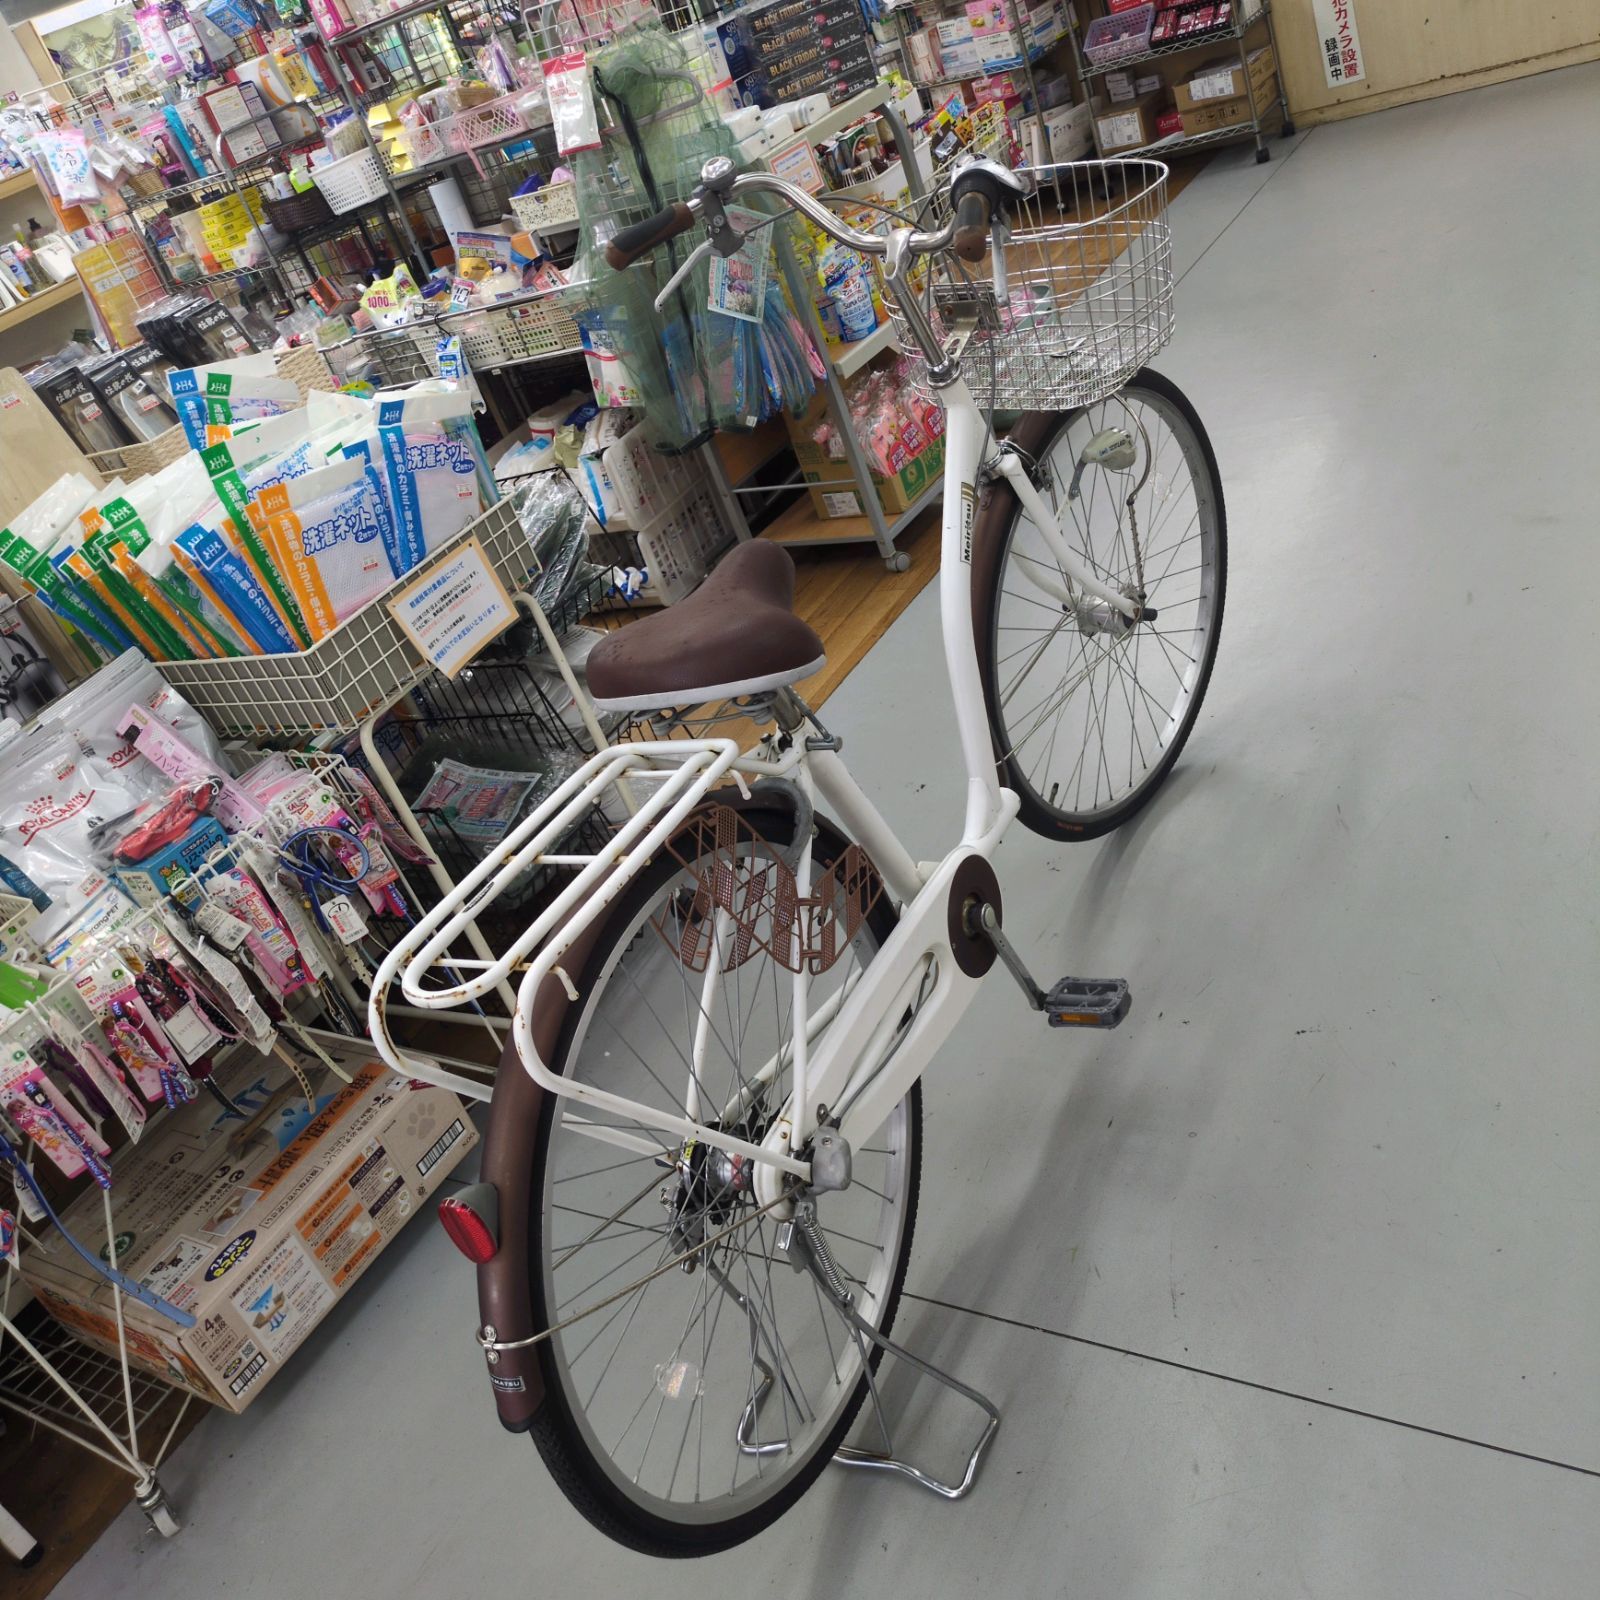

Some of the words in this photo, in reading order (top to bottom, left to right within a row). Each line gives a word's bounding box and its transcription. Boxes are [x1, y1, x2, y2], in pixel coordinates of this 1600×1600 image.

[754, 11, 778, 31] BLACK
[779, 2, 805, 22] FRIDAY
[762, 34, 785, 53] BLACK
[787, 24, 811, 41] FRIDAY
[769, 56, 793, 77] BLACK
[794, 46, 818, 65] FRIDAY
[1325, 37, 1342, 80] 録画中
[777, 79, 801, 98] BLACK
[801, 69, 825, 88] FRIDAY
[55, 382, 87, 405] 伝説の技
[104, 372, 135, 396] 伝説の技
[405, 439, 470, 471] 洗濯ネット
[302, 506, 372, 556] 洗濯ネット
[964, 503, 972, 561] Meiritsu
[106, 744, 138, 763] ROYA
[19, 816, 54, 836] ROYAL
[51, 791, 86, 819] CANIN
[246, 899, 272, 929] COLLAR
